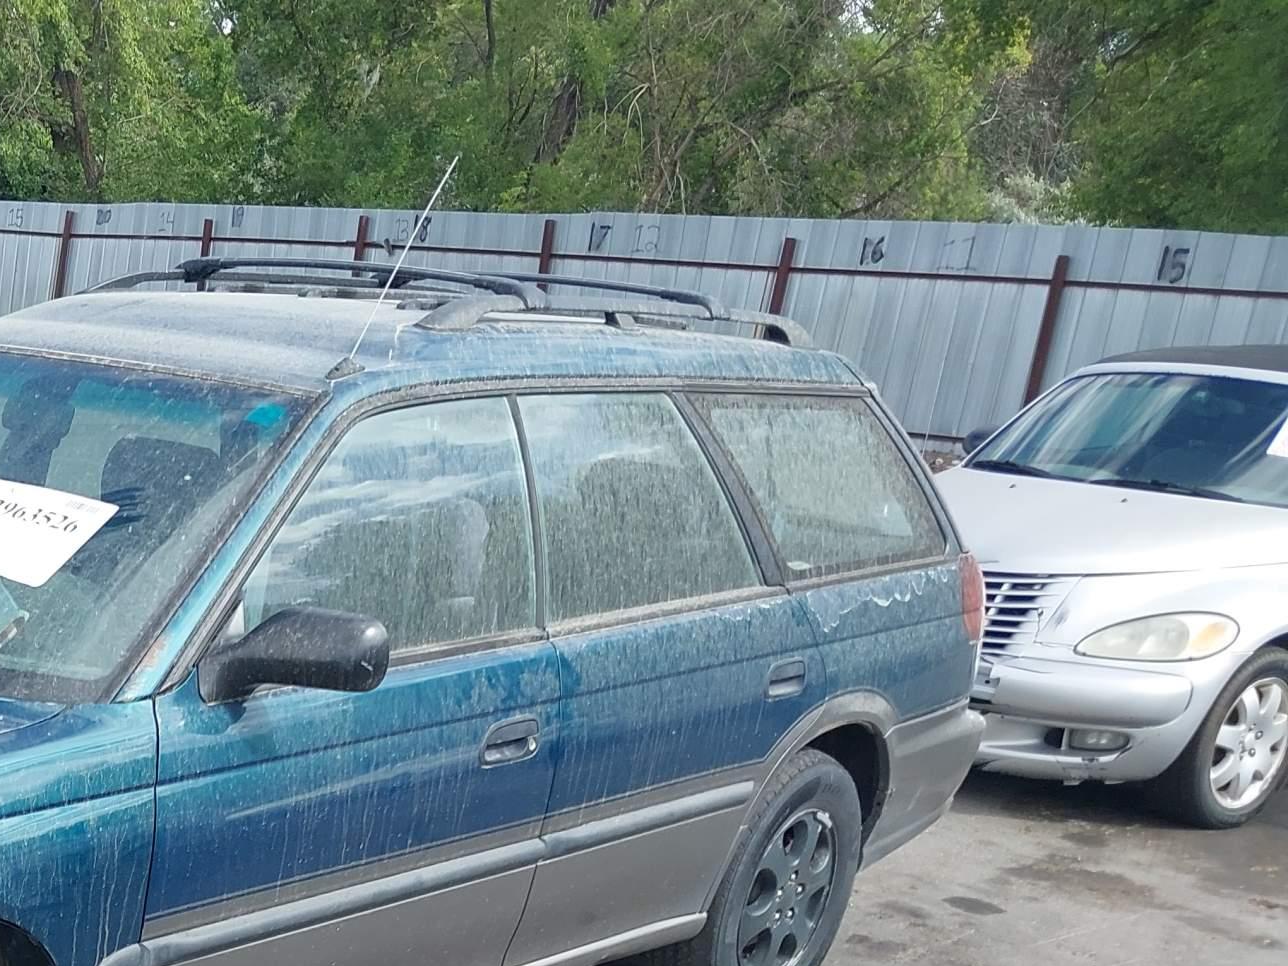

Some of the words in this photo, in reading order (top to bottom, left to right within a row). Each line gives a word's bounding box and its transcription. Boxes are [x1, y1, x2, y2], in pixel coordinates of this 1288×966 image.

[8, 207, 24, 228] 15
[158, 210, 176, 233] 14
[587, 221, 612, 252] 17
[630, 223, 662, 254] 12
[858, 236, 885, 266] 16
[1157, 245, 1191, 284] 15
